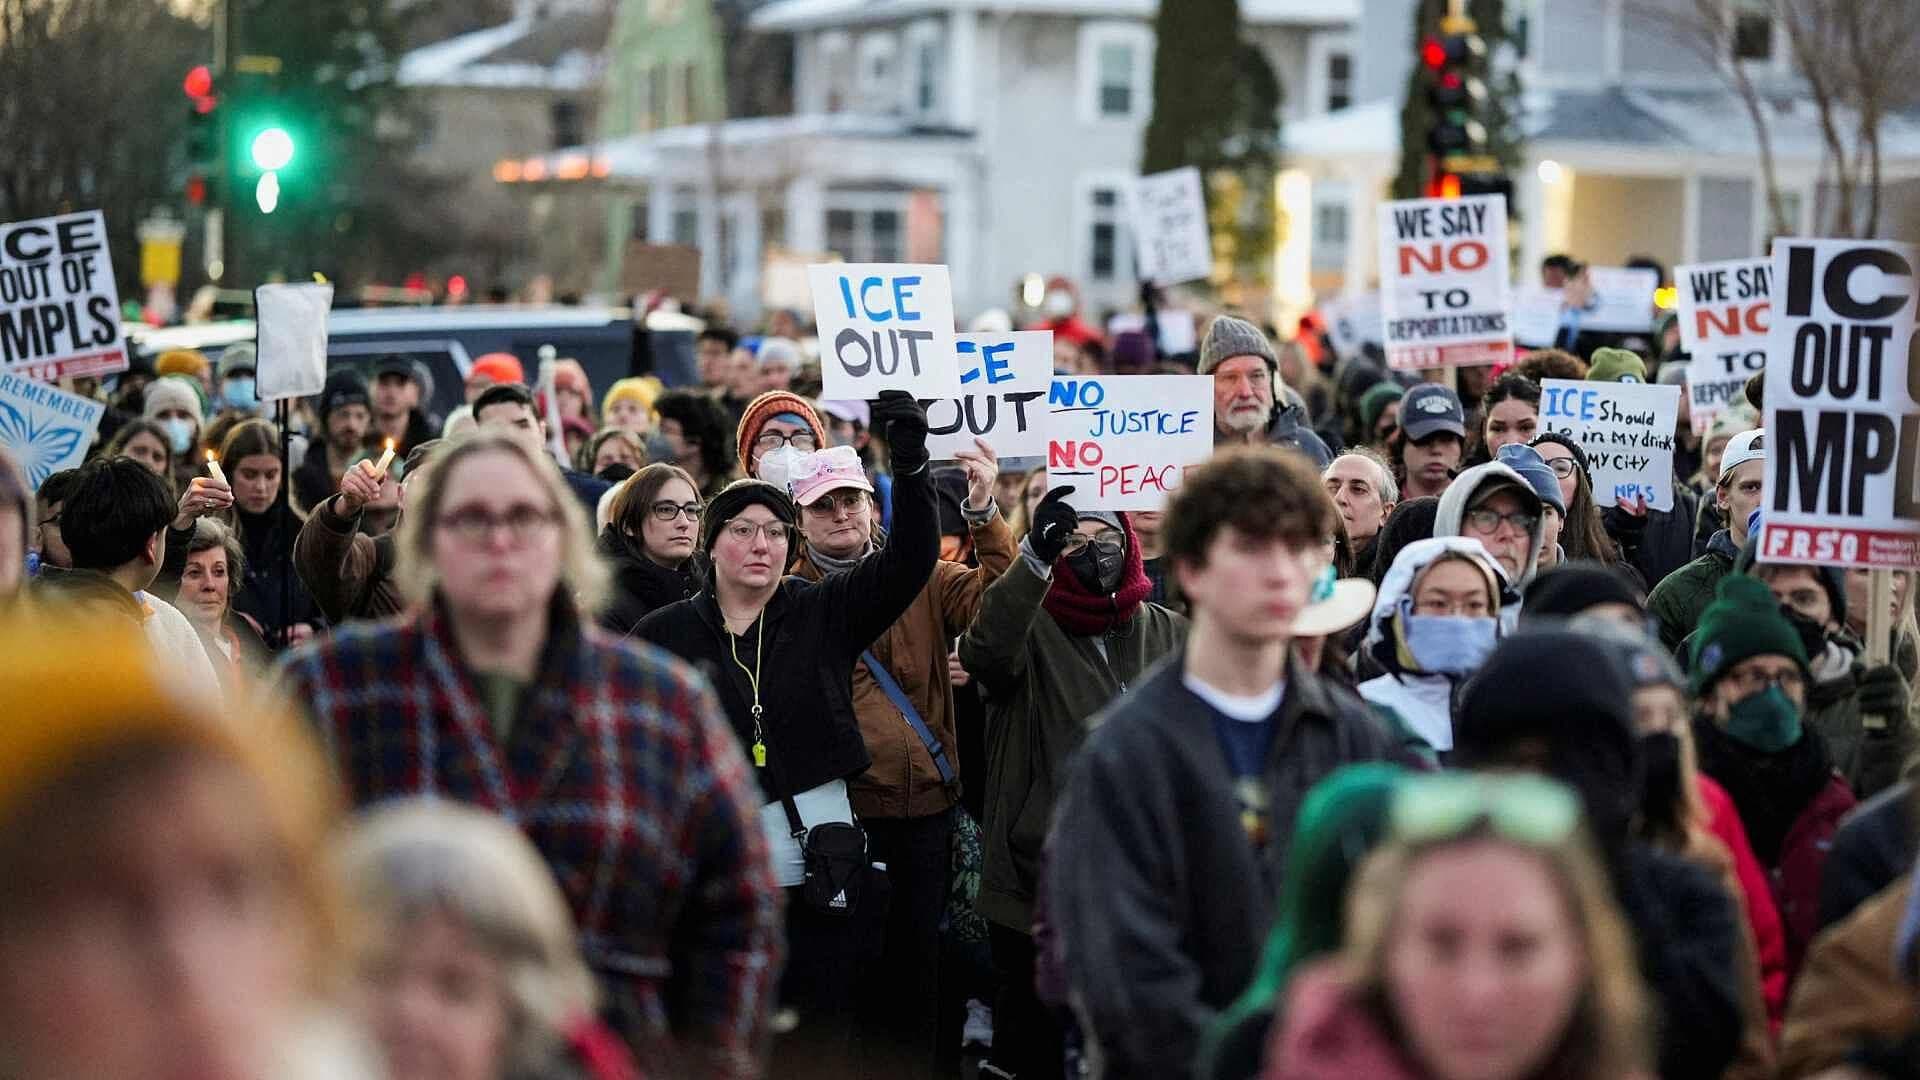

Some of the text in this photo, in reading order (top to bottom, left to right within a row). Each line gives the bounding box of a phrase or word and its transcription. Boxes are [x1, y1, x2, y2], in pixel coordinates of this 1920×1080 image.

[1395, 204, 1486, 239] WE SAY
[0, 218, 101, 265] CE
[1397, 241, 1488, 276] NO
[0, 256, 96, 303] OUT OF
[1691, 264, 1774, 302] WE SA
[1786, 246, 1920, 322] IC
[839, 276, 921, 322] ICE
[1418, 289, 1469, 309] TO
[0, 297, 116, 363] MPLS
[1389, 314, 1506, 340] DEPORTATIONS
[835, 328, 933, 377] OUT
[955, 342, 1017, 384] CE
[1717, 351, 1766, 373] TO
[1791, 322, 1893, 402] OUT
[0, 374, 96, 422] REMEMBER
[918, 391, 1046, 435] OUT
[1049, 381, 1105, 407] NO
[1546, 388, 1598, 420] ICE
[1090, 410, 1199, 437] JUSTICE
[1582, 425, 1605, 443] in
[1641, 429, 1674, 451] drink
[1049, 440, 1104, 469] NO
[1613, 455, 1650, 471] City
[1773, 409, 1920, 519] MPL
